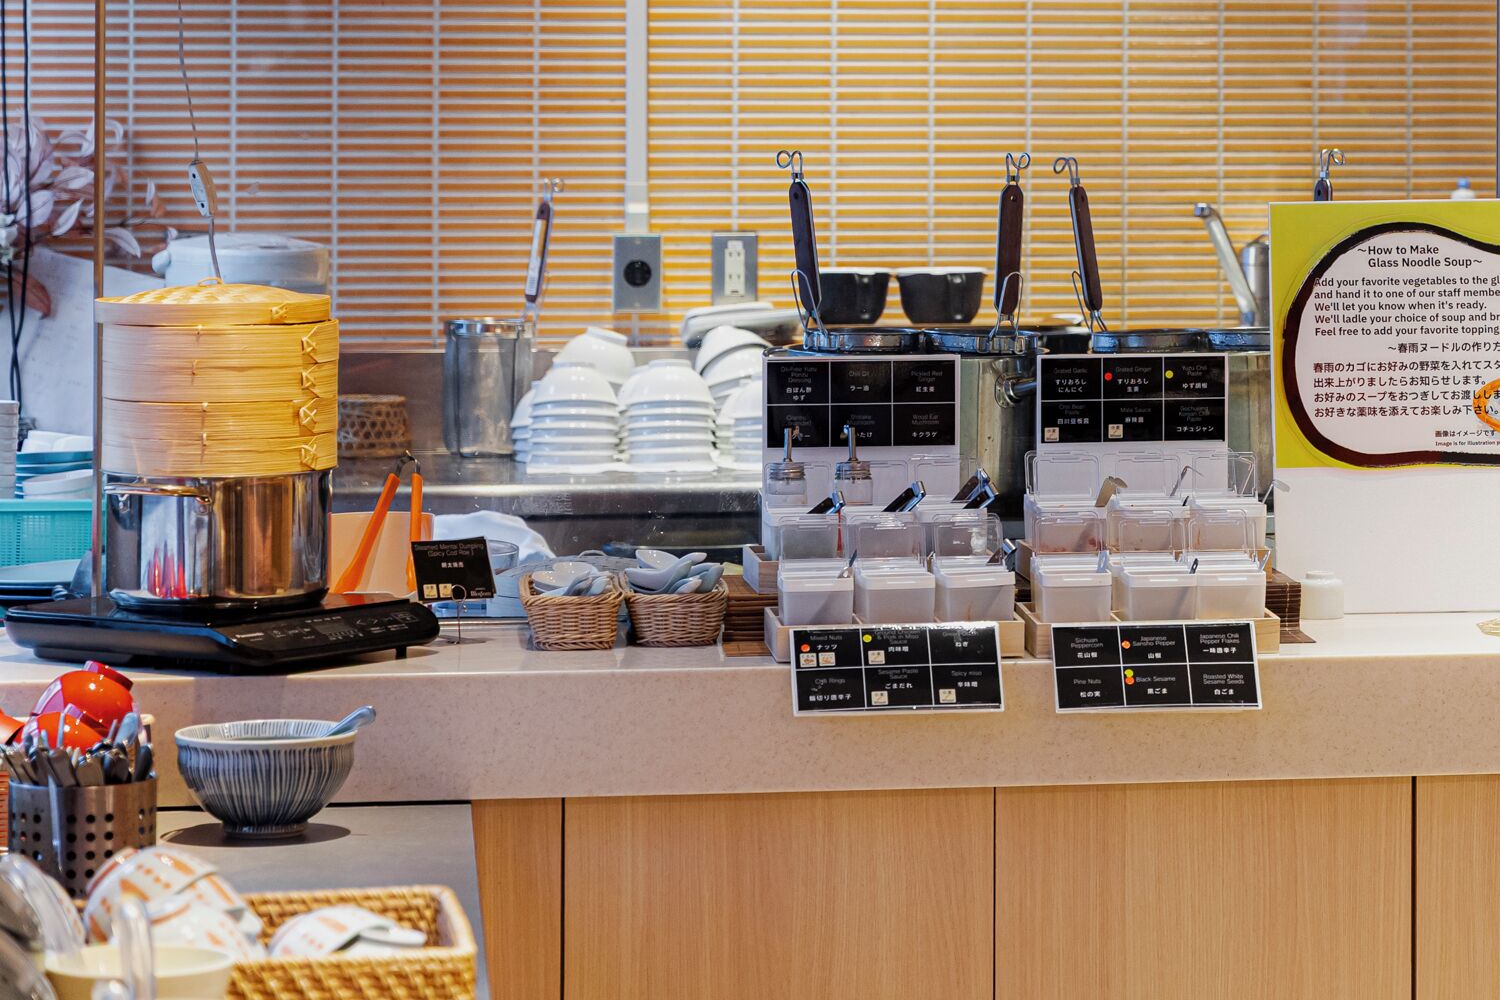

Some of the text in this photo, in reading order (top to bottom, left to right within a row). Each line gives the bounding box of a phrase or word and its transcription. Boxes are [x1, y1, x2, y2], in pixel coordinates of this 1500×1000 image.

[1395, 245, 1407, 255] to
[1410, 244, 1439, 255] Make
[1368, 257, 1399, 268] Glass
[1401, 256, 1441, 267] Noodle
[1313, 277, 1334, 287] Add
[1336, 279, 1359, 289] your
[1361, 276, 1400, 286] favorite
[1402, 276, 1457, 288] vegetables
[1459, 276, 1470, 285] to
[1472, 275, 1489, 285] the
[1313, 289, 1333, 299] and
[1335, 289, 1361, 299] hand
[1363, 289, 1371, 299] it
[1372, 290, 1383, 299] to
[1385, 290, 1404, 298] one
[1406, 288, 1417, 298] of
[1418, 290, 1436, 298] our
[1437, 287, 1461, 298] staff
[1314, 300, 1487, 313] We'll let you know when it's ready.
[1314, 314, 1340, 324] We'll
[1342, 314, 1368, 324] ladle
[1369, 315, 1392, 325] your
[1394, 313, 1427, 323] choice
[1429, 312, 1439, 322] of
[1441, 314, 1466, 324] soup
[1468, 312, 1487, 322] and
[1315, 327, 1337, 337] Feel
[1338, 326, 1359, 336] free
[1360, 327, 1372, 336] to
[1373, 326, 1393, 336] add
[1395, 328, 1418, 337] your
[1420, 325, 1459, 335] favorite
[1313, 375, 1486, 389] 出来上がりましたらお知らせします。
